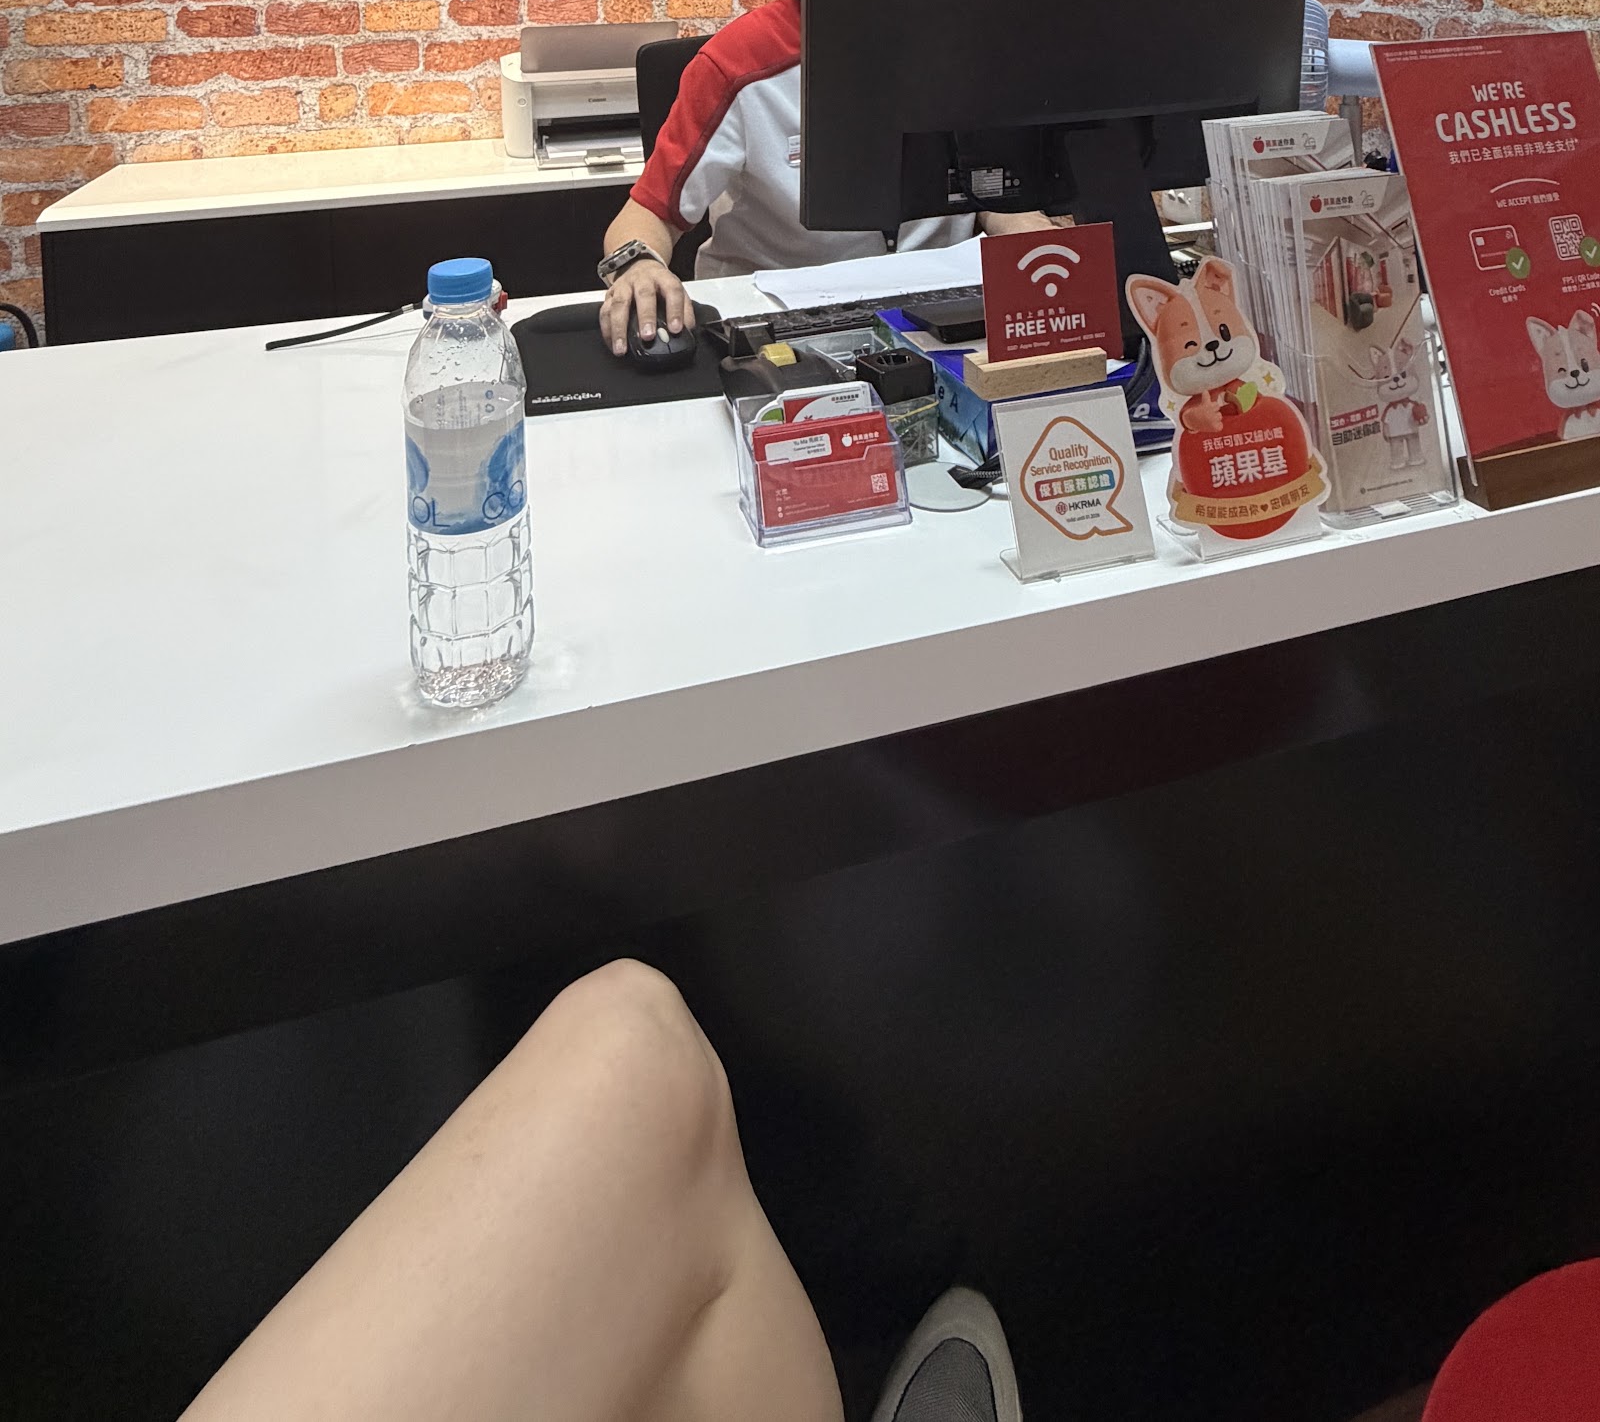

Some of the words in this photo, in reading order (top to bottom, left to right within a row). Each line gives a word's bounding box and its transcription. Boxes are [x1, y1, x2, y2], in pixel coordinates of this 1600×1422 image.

[1471, 81, 1526, 103] WE'RE
[1435, 101, 1577, 143] CASHLESS
[1508, 196, 1532, 207] ACCEPT
[1005, 318, 1047, 339] FREE
[1048, 313, 1086, 333] WIFI
[1049, 443, 1089, 461] Quality
[1030, 462, 1062, 477] Service
[1063, 454, 1112, 472] Recognition
[1208, 445, 1289, 489] 蘋果基
[1038, 472, 1112, 498] 優質服務認證
[1068, 499, 1102, 512] HKRMA
